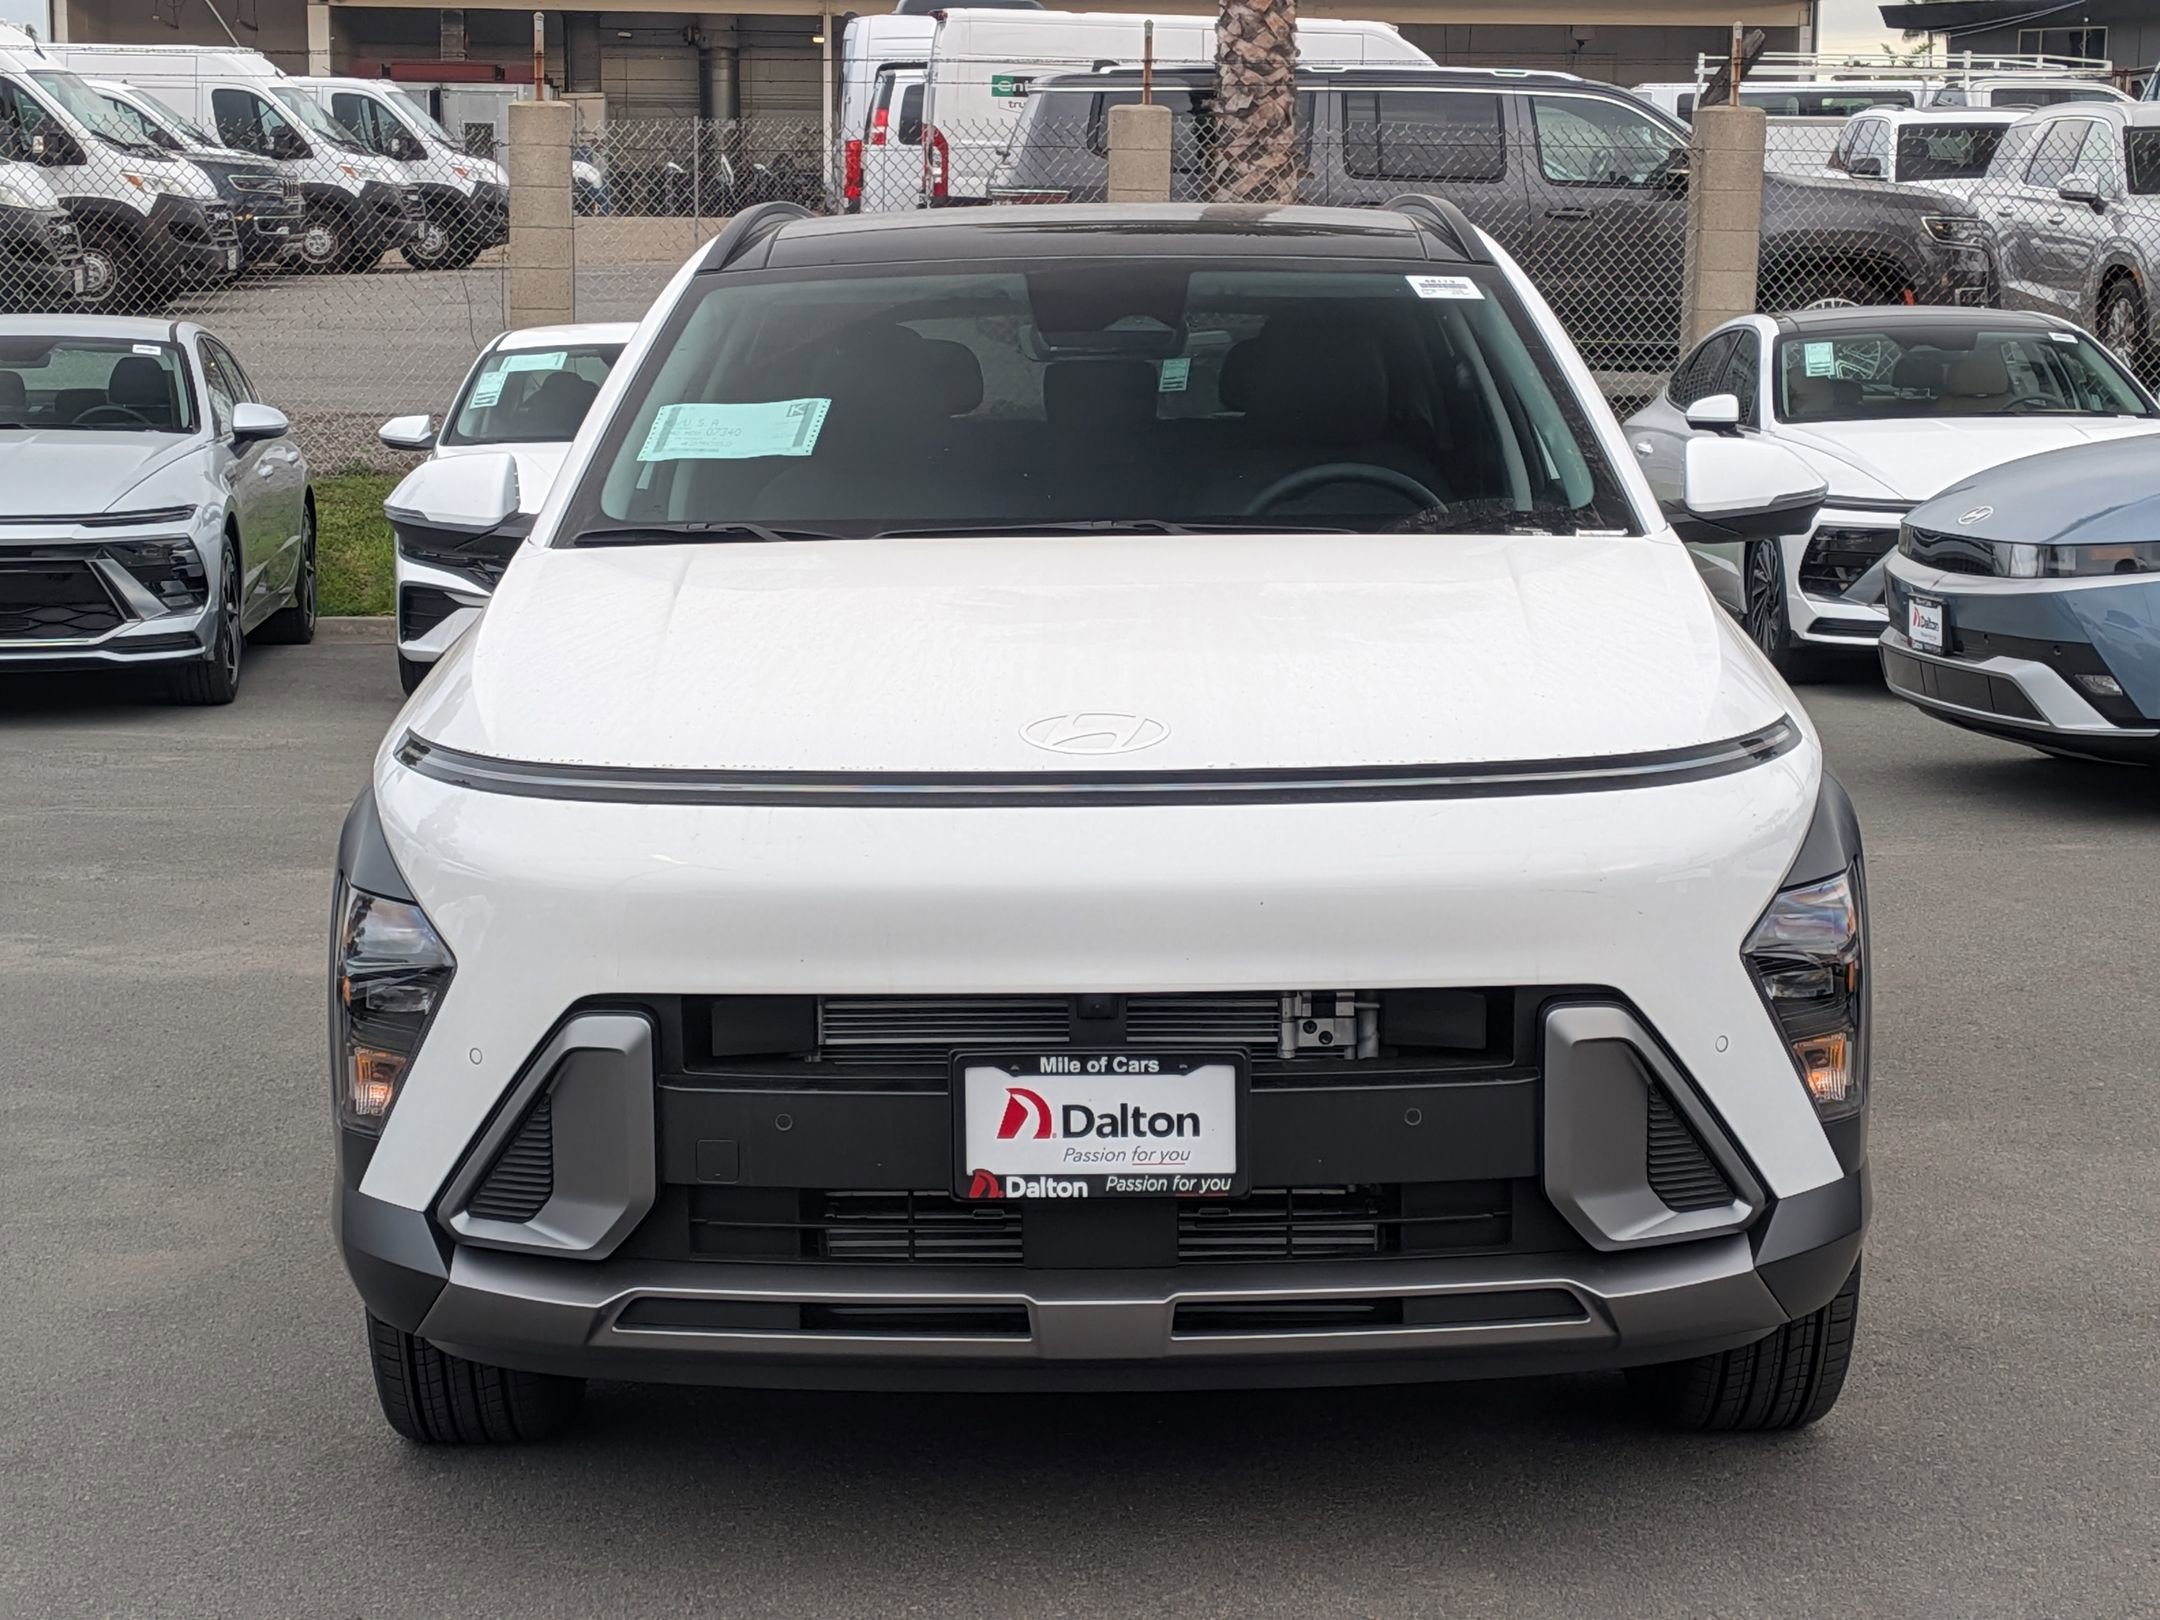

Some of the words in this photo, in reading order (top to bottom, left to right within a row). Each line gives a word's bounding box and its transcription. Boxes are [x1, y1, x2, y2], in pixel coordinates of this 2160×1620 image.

[1040, 1056, 1081, 1073] Mile
[1086, 1056, 1108, 1073] of
[1112, 1056, 1160, 1073] Cars
[1062, 1103, 1201, 1139] Dalton
[1063, 1147, 1127, 1163] Passion
[1132, 1145, 1157, 1162] for
[1160, 1150, 1191, 1165] you
[1006, 1175, 1088, 1198] Dalton
[1105, 1175, 1168, 1192] Passion
[1172, 1174, 1197, 1192] for
[1199, 1178, 1232, 1194] you
